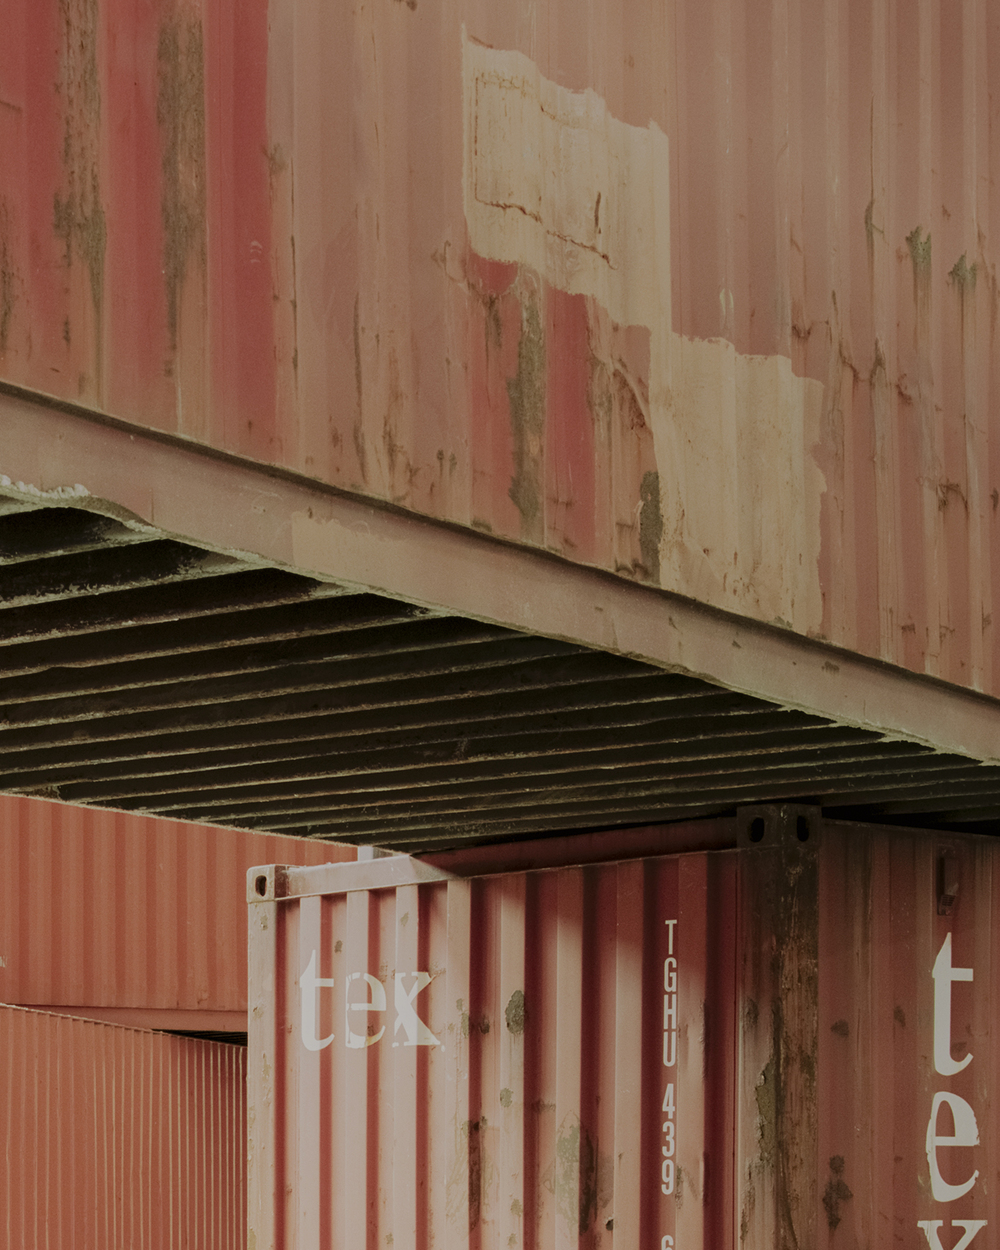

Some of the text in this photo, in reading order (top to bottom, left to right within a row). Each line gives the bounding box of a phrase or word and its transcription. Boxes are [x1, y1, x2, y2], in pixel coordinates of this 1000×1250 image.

[299, 949, 441, 1052] tex
[662, 919, 678, 1068] TGHU
[660, 1083, 676, 1195] 439
